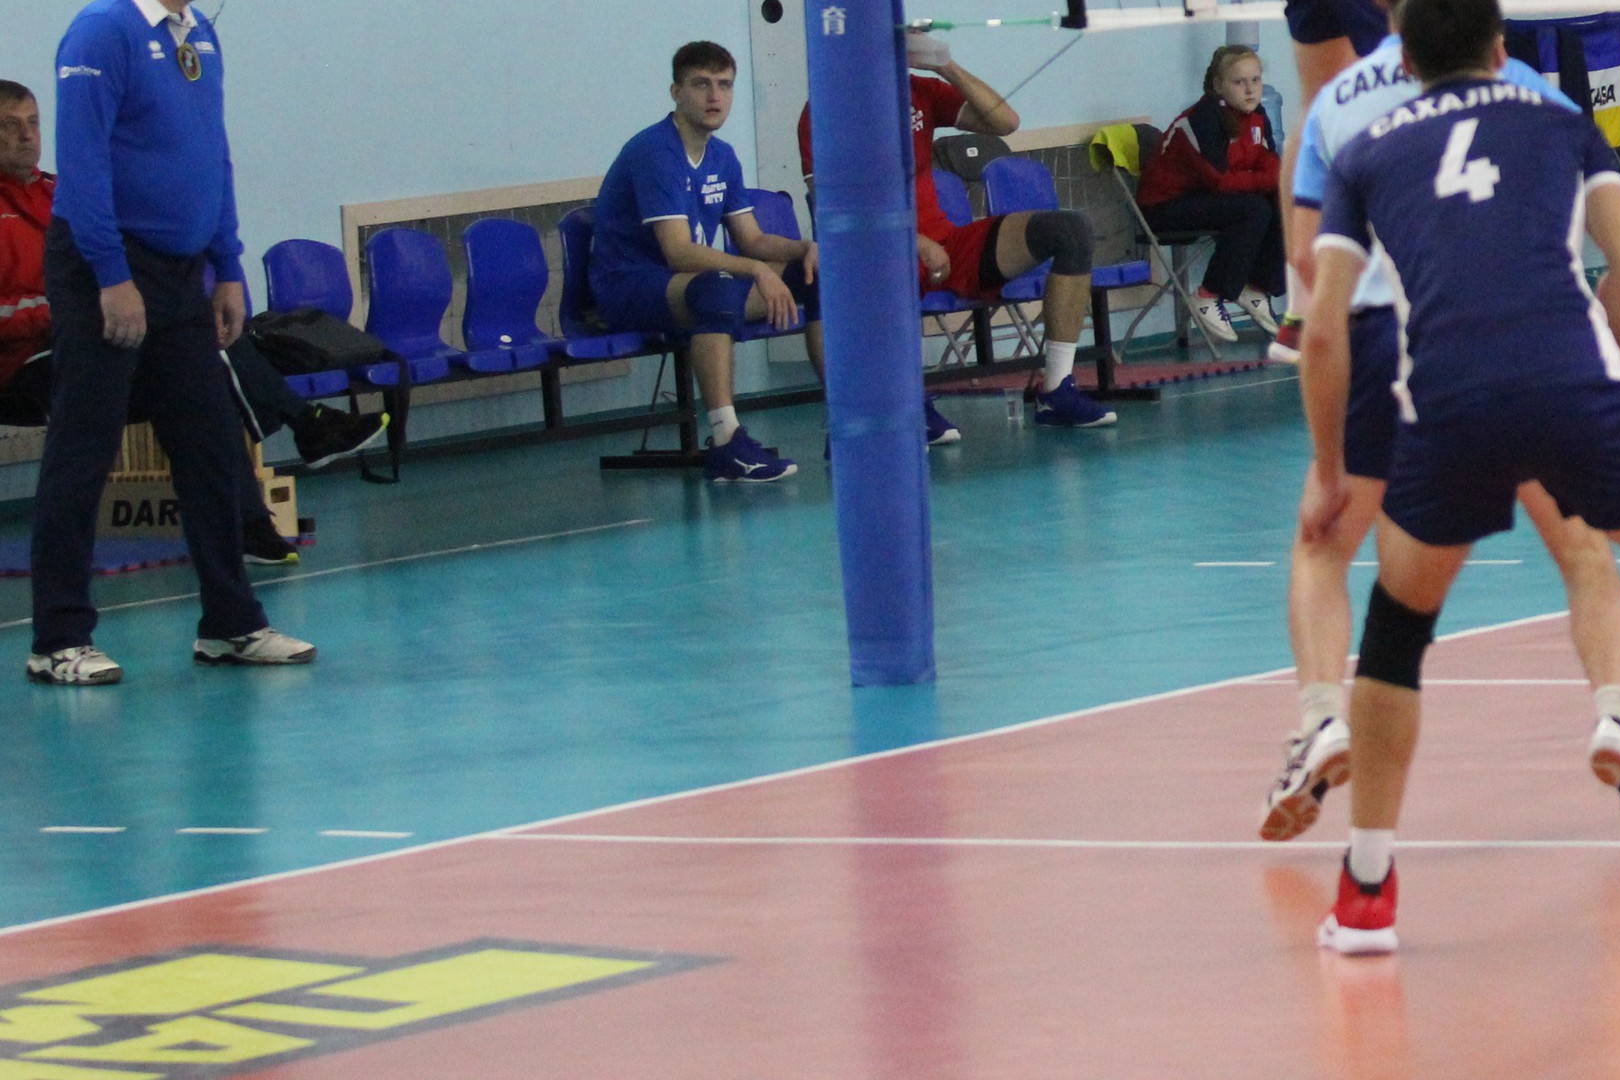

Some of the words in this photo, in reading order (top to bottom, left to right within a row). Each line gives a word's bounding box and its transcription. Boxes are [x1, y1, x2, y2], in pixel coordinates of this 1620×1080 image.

[1335, 63, 1411, 106] САХА
[1368, 83, 1543, 139] САХАЛИН
[1434, 117, 1501, 204] 4
[111, 499, 180, 527] DAR
